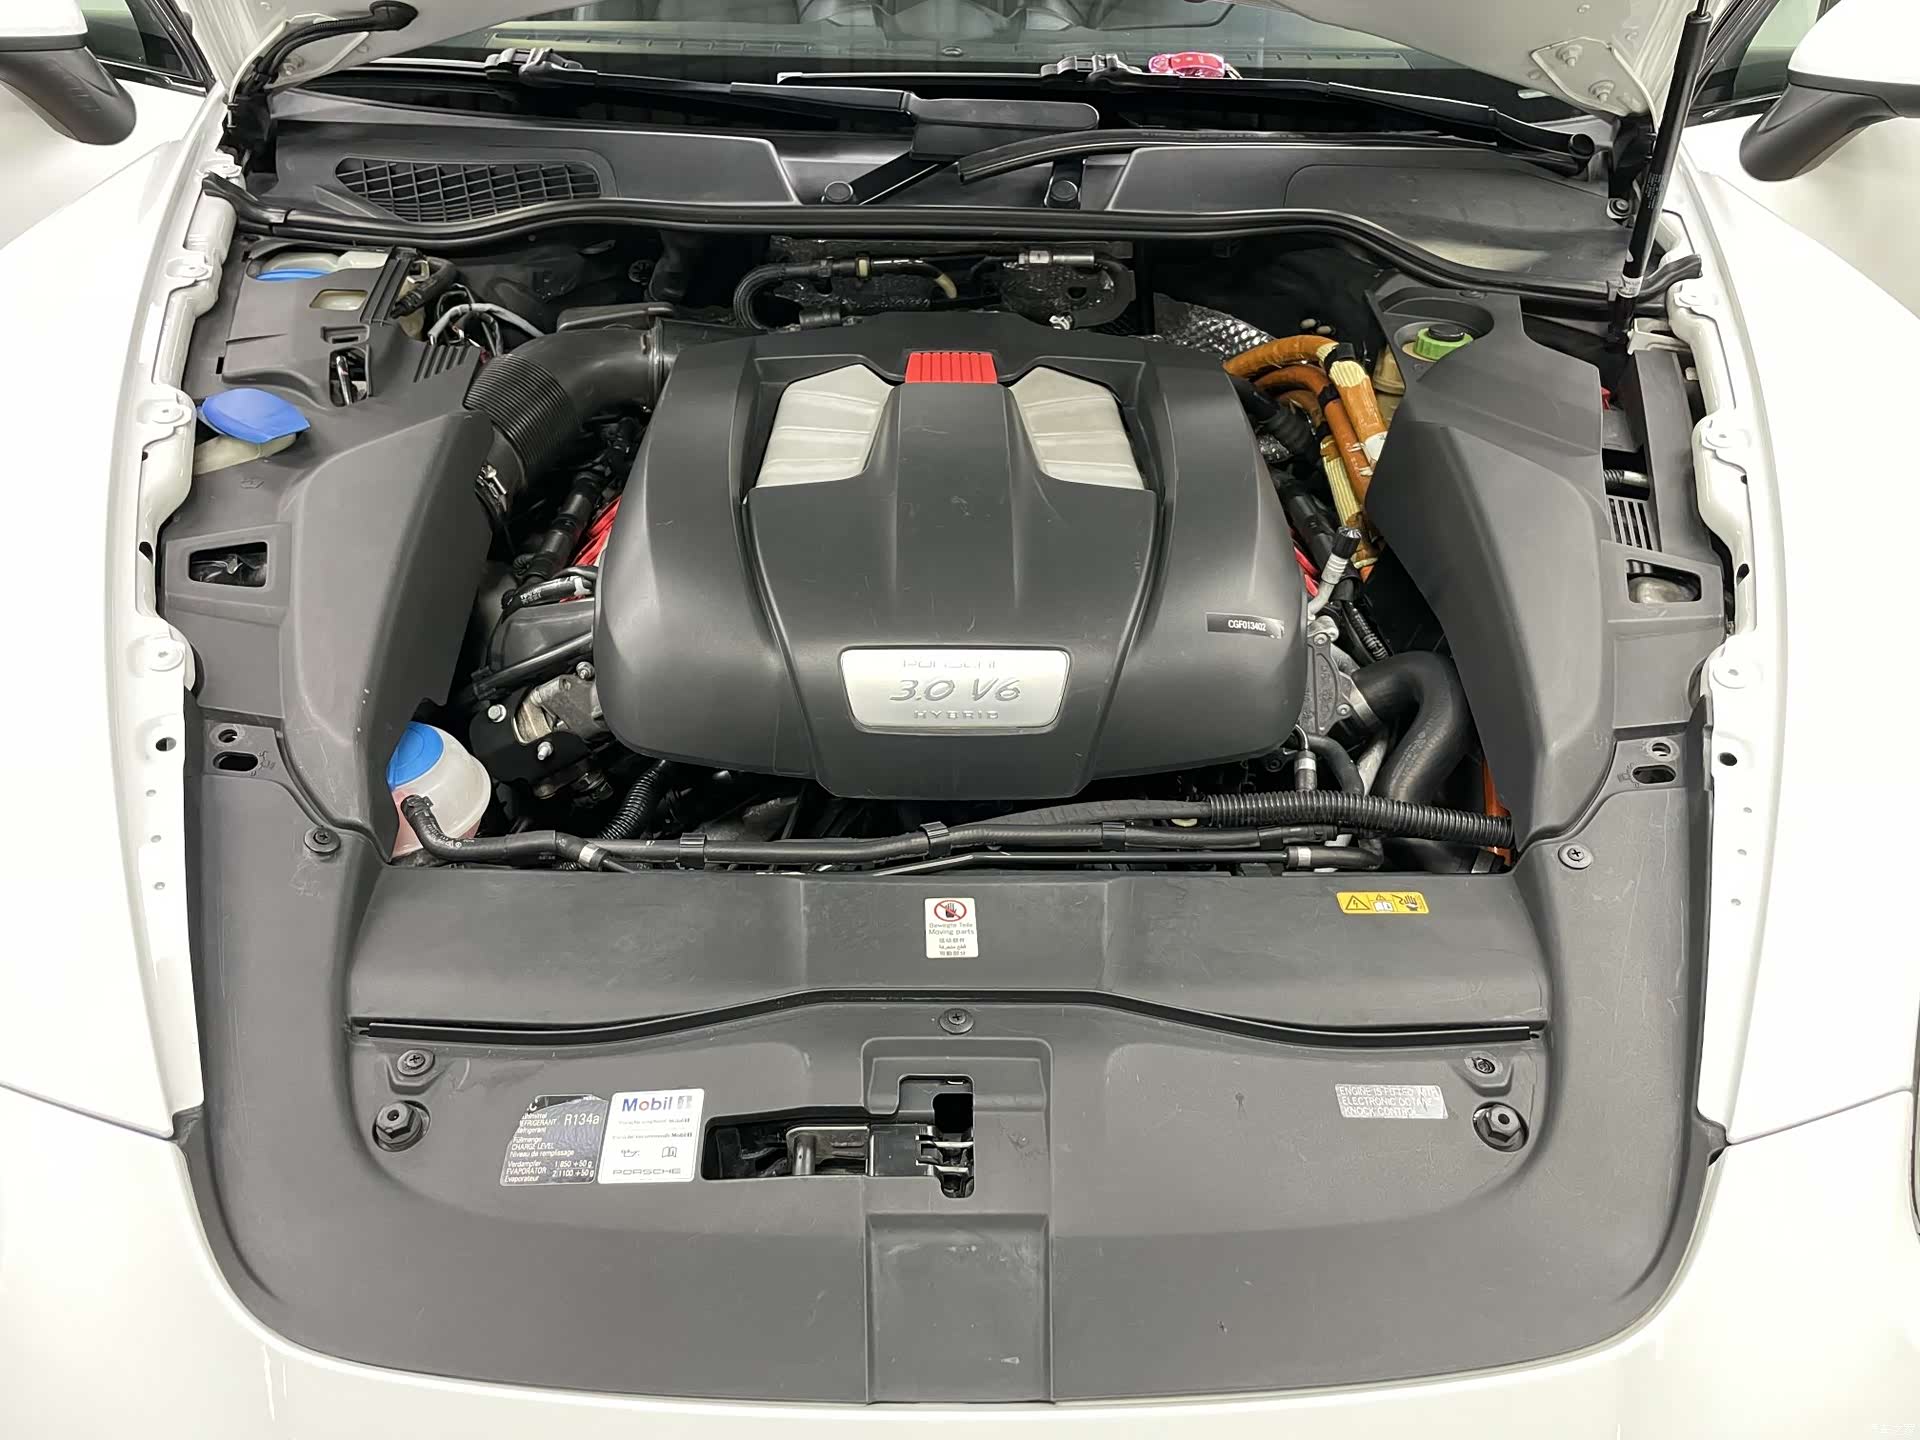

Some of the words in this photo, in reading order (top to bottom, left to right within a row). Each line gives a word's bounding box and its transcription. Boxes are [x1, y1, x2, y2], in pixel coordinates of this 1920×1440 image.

[1228, 619, 1267, 632] CGF013402
[889, 679, 956, 702] 3.0
[971, 677, 1021, 702] V6
[913, 710, 999, 720] HYBRID
[1339, 1087, 1372, 1096] ENGINE
[1373, 1087, 1383, 1096] IS
[1384, 1087, 1414, 1096] FITTED
[622, 1096, 673, 1112] Mobil
[1341, 1096, 1396, 1106] ELECTRONIC
[564, 1112, 600, 1126] R134a
[536, 1142, 555, 1150] LEVEL
[539, 1150, 575, 1158] remplissage
[507, 1160, 542, 1169] Verdampfer
[506, 1167, 547, 1175] EVAPORATOR
